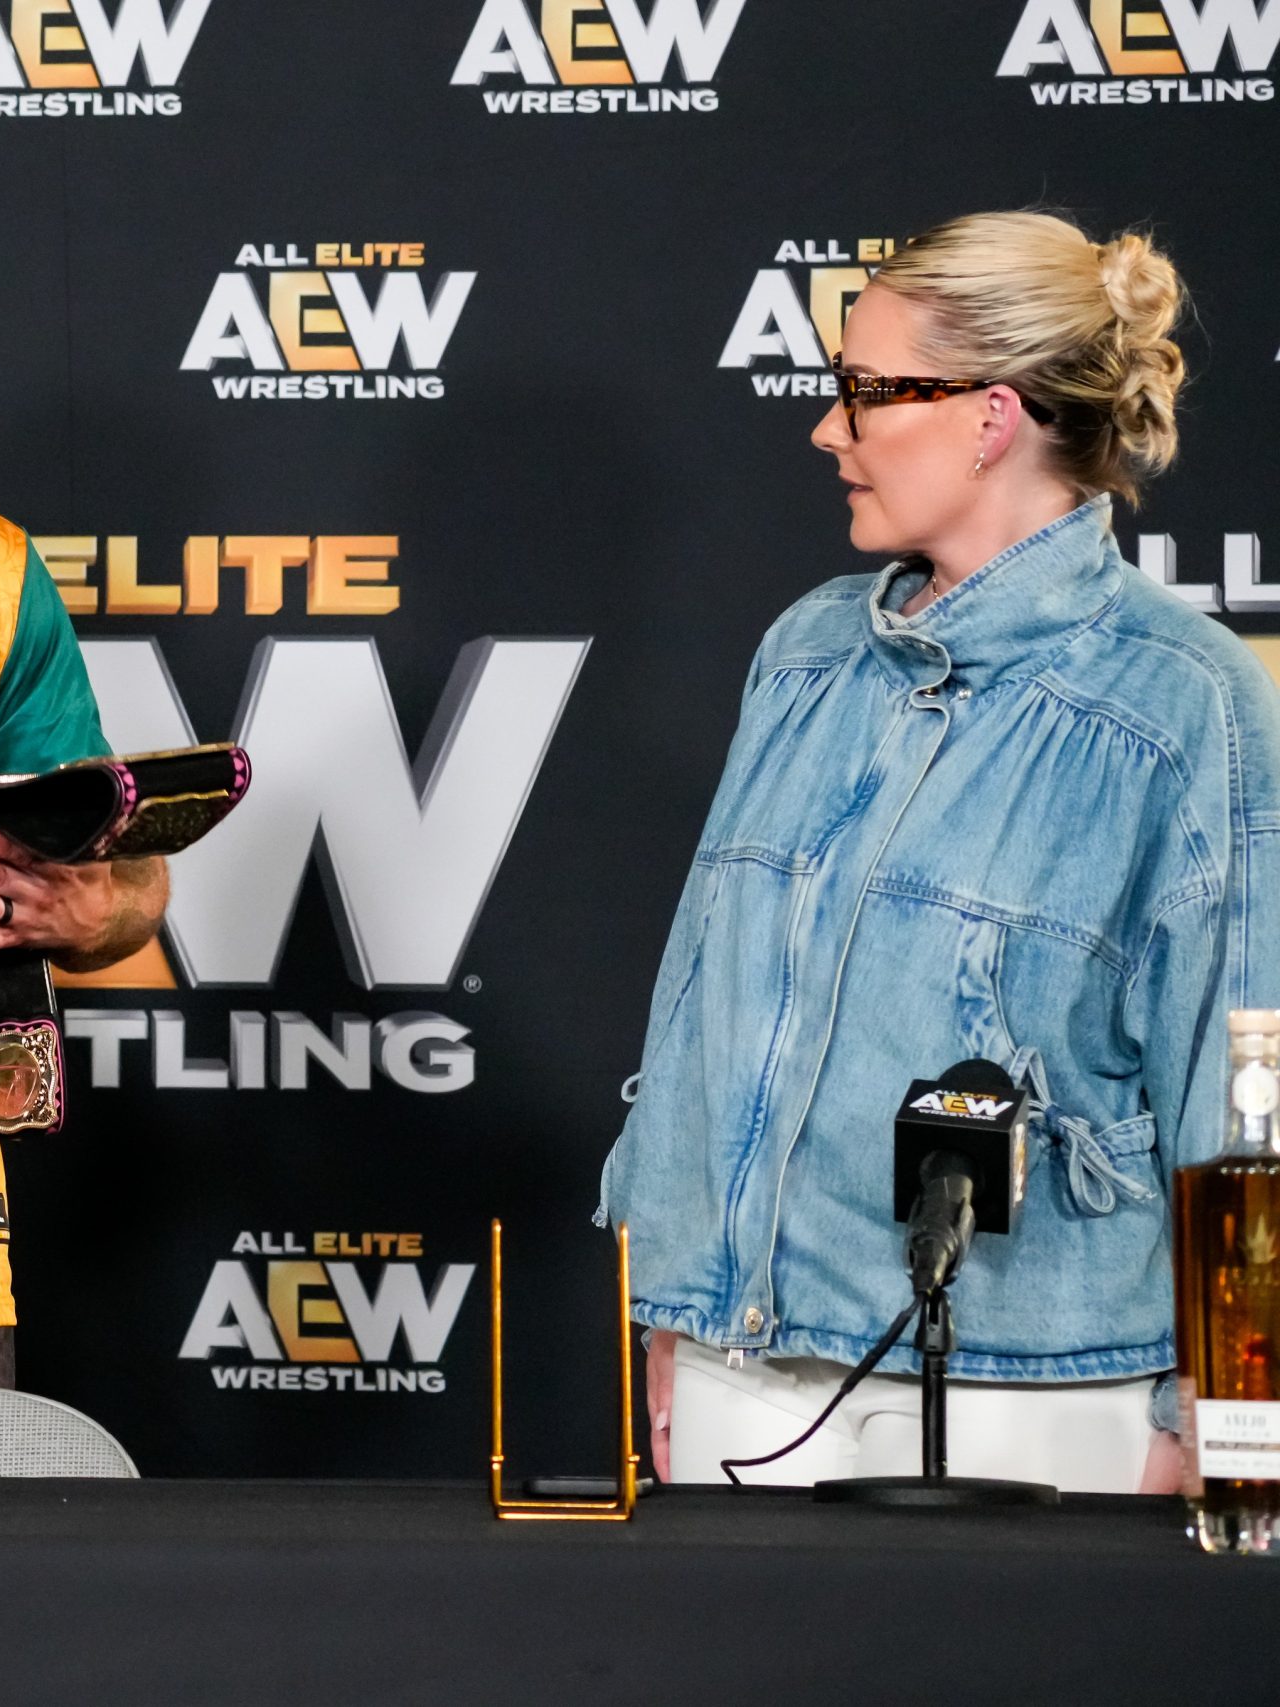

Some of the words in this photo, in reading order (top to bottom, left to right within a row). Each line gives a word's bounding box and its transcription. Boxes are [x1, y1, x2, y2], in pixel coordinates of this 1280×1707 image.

[449, 0, 746, 85] AEW
[995, 0, 1280, 77] AEW
[483, 89, 719, 114] WRESTLING
[1030, 78, 1275, 106] WRESTLING
[234, 243, 308, 267] ALL
[315, 243, 424, 267] ELITE
[774, 239, 851, 263] ALL
[179, 271, 478, 371] AEW
[212, 375, 445, 399] WRESTLING
[34, 535, 400, 615] ELITE
[909, 1092, 1014, 1116] AEW
[232, 1232, 306, 1254] ALL
[313, 1232, 424, 1257] ELITE
[177, 1260, 477, 1363] AEW
[210, 1366, 446, 1393] WRESTLING
